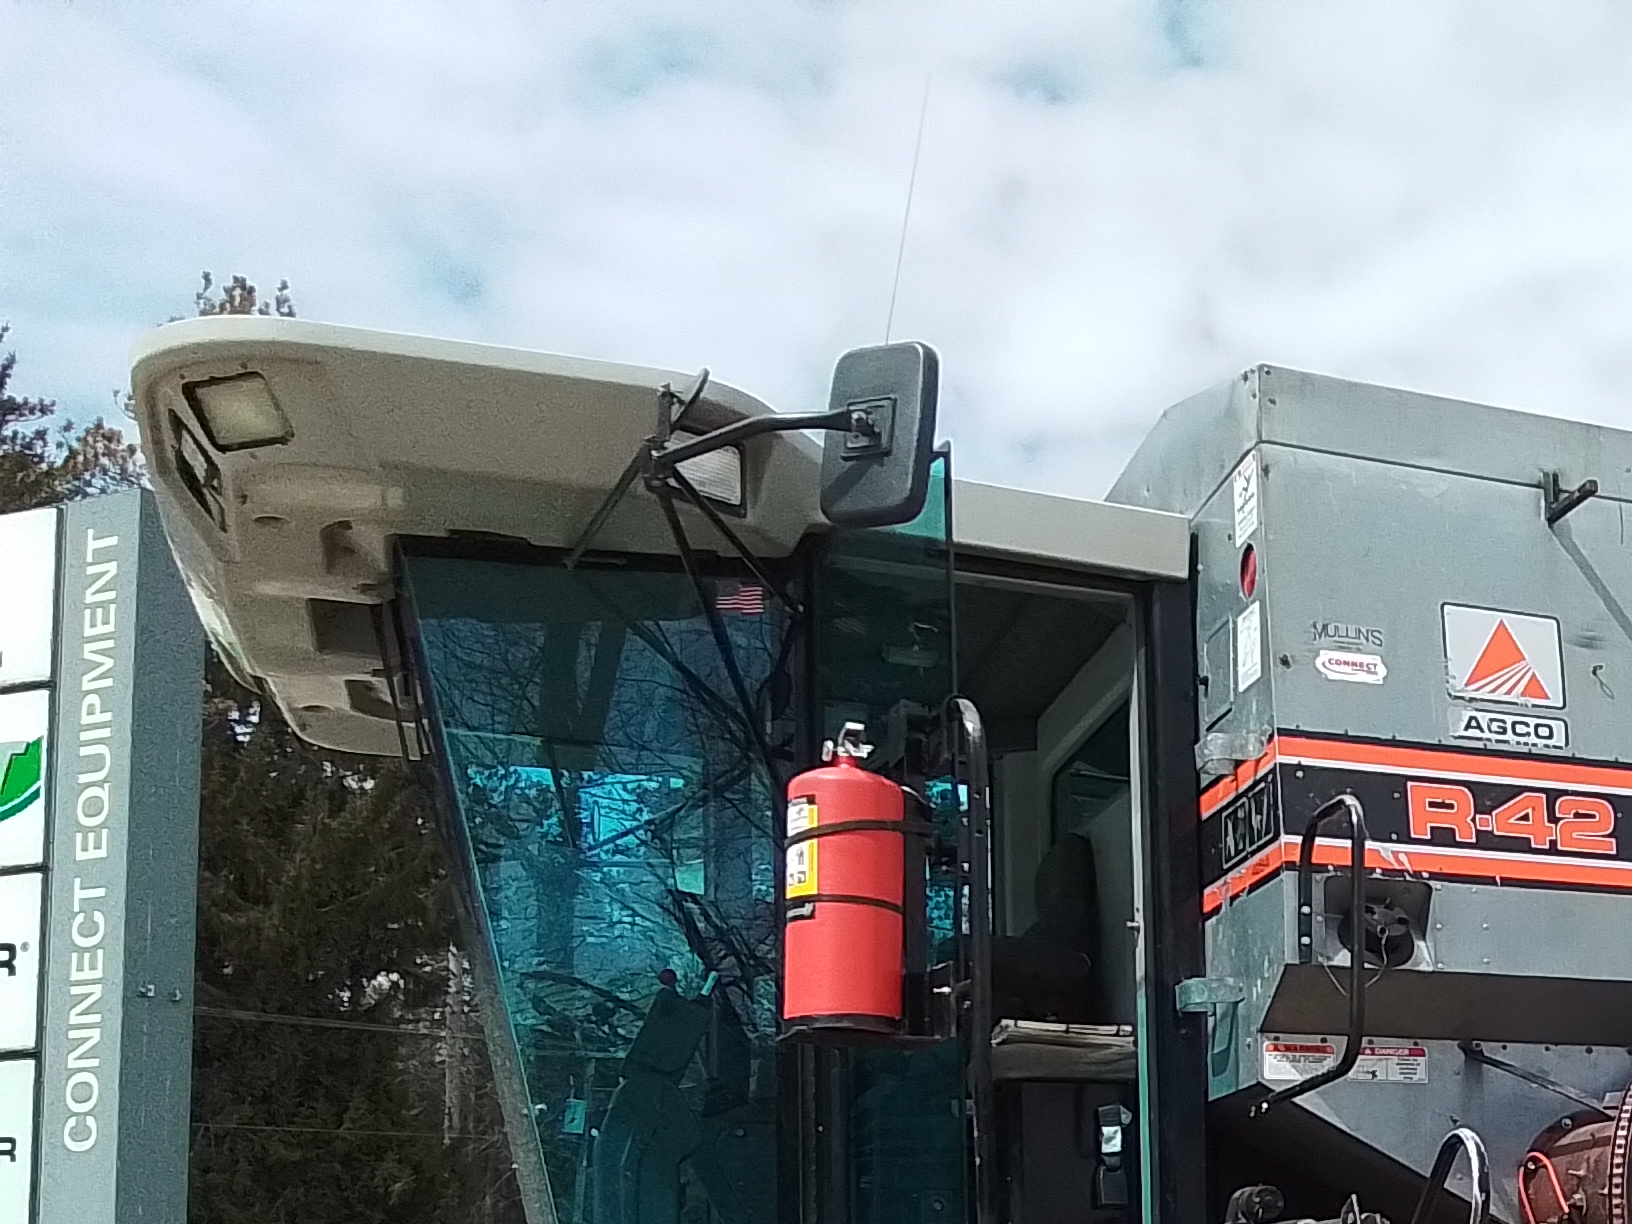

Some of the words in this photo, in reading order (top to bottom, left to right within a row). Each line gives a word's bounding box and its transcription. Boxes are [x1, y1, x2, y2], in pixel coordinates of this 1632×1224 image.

[75, 528, 119, 862] EQUIPMENT
[1462, 714, 1556, 741] AGCO
[63, 877, 107, 1152] CONNECT
